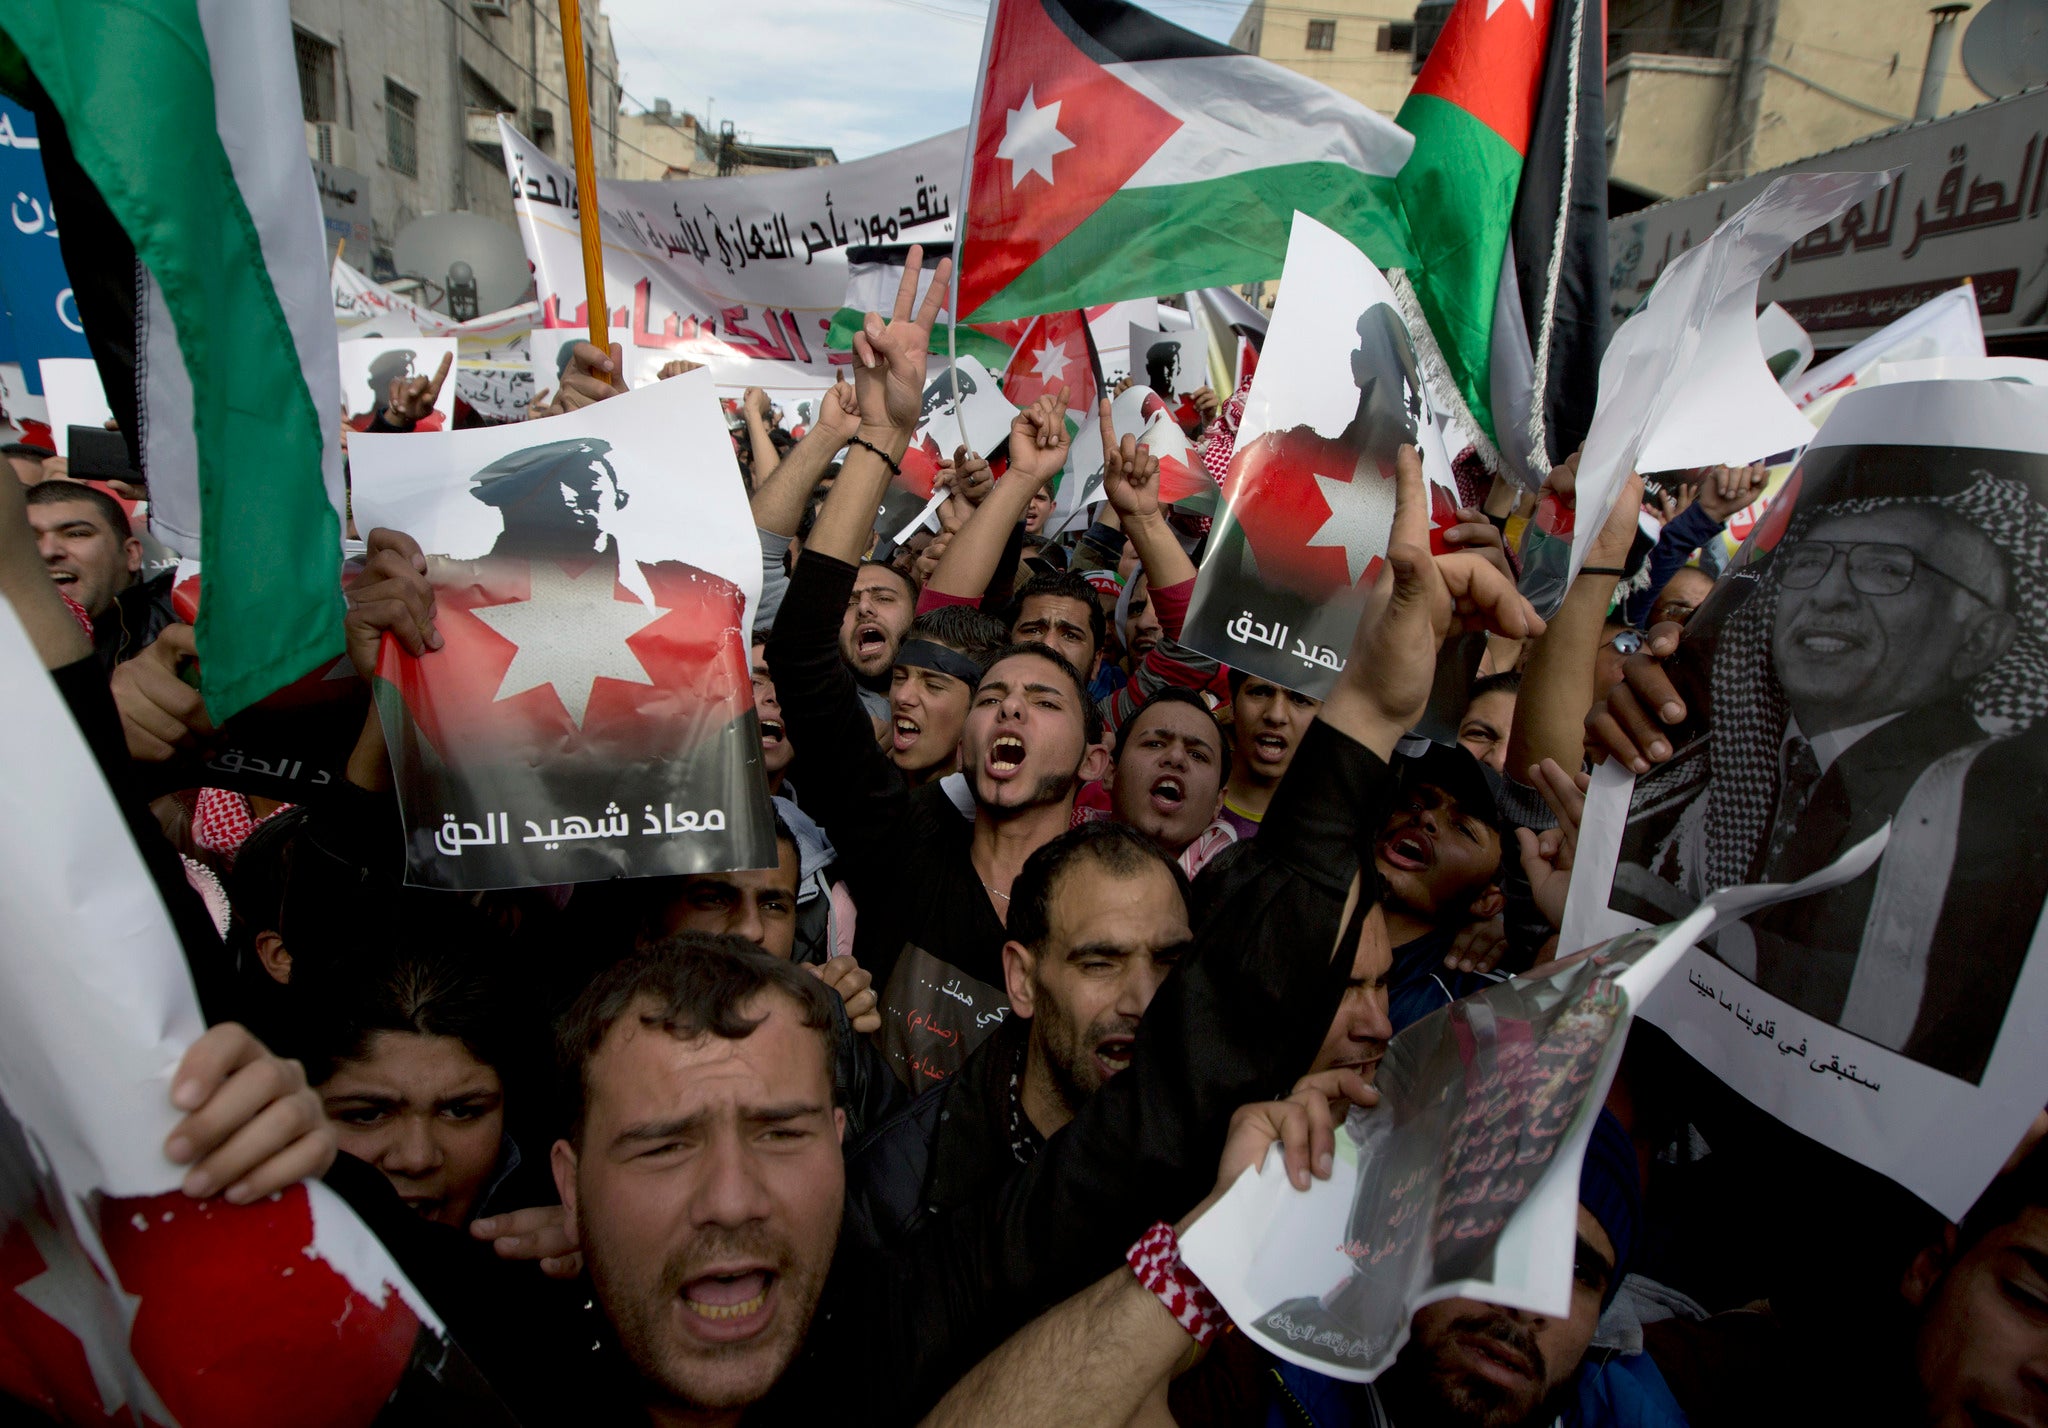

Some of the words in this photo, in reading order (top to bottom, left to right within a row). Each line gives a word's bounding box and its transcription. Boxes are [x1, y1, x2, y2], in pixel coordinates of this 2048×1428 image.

[855, 175, 952, 246] يتقدمون
[706, 203, 795, 275] التعازي
[1226, 610, 1289, 650] الحق
[206, 749, 302, 780] الحق
[434, 812, 509, 856] الحق
[522, 801, 630, 850] شهيد
[642, 802, 726, 835] معاذ
[1719, 990, 1732, 1012] ما
[1735, 1003, 1776, 1039] قلوبنا
[1778, 1038, 1807, 1058] في
[1809, 1055, 1881, 1092] ستبقى
